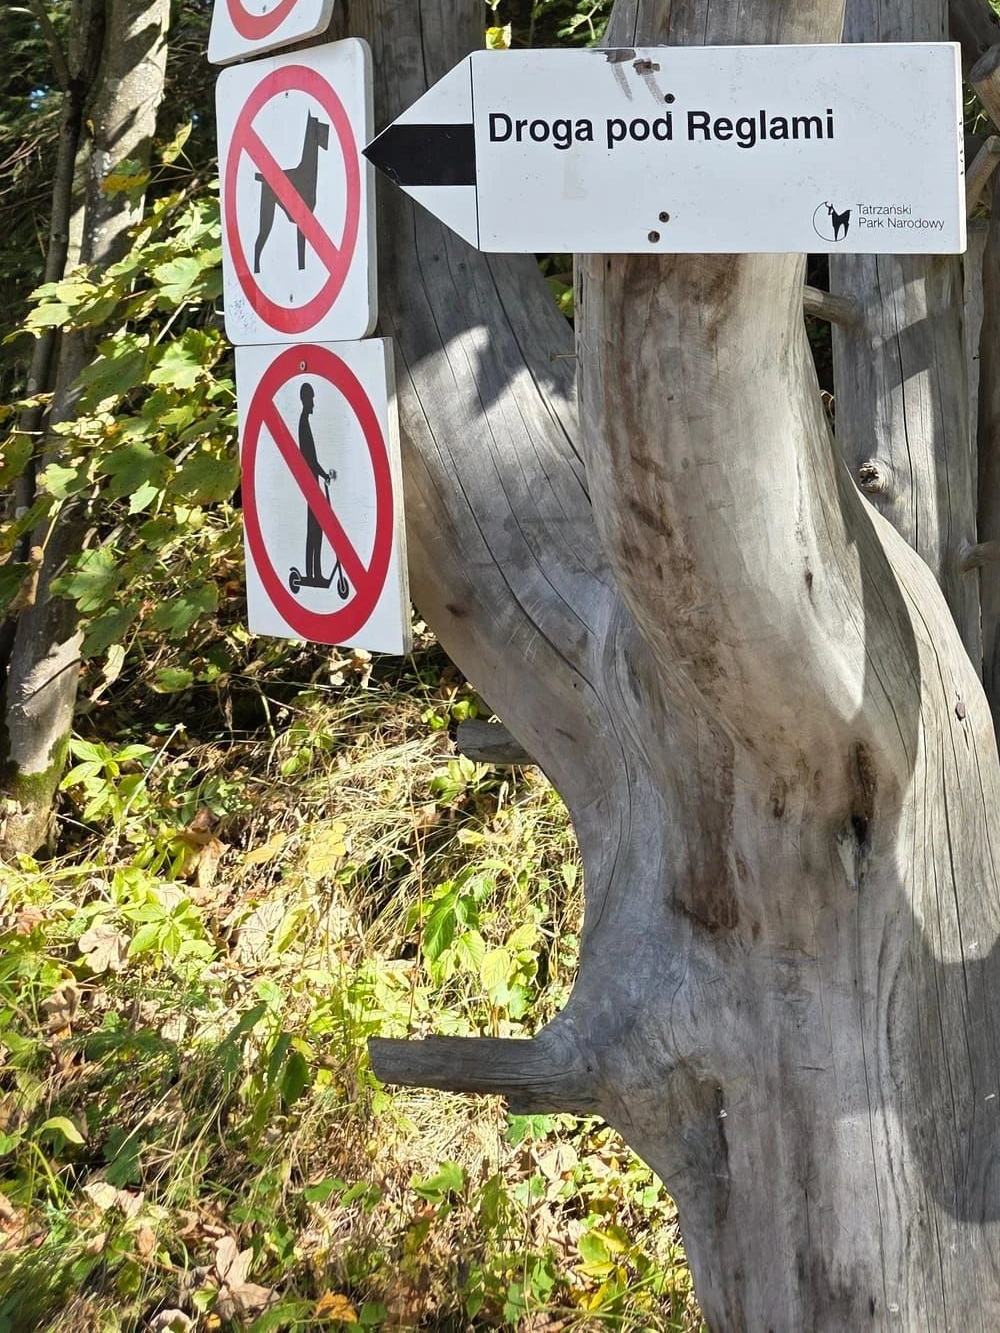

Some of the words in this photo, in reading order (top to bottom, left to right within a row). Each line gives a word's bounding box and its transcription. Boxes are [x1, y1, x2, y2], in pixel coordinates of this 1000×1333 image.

[488, 112, 594, 151] Droga
[606, 110, 673, 150] pod
[686, 108, 834, 149] Reglami
[858, 216, 885, 229] Park
[887, 217, 945, 231] Narodowy
